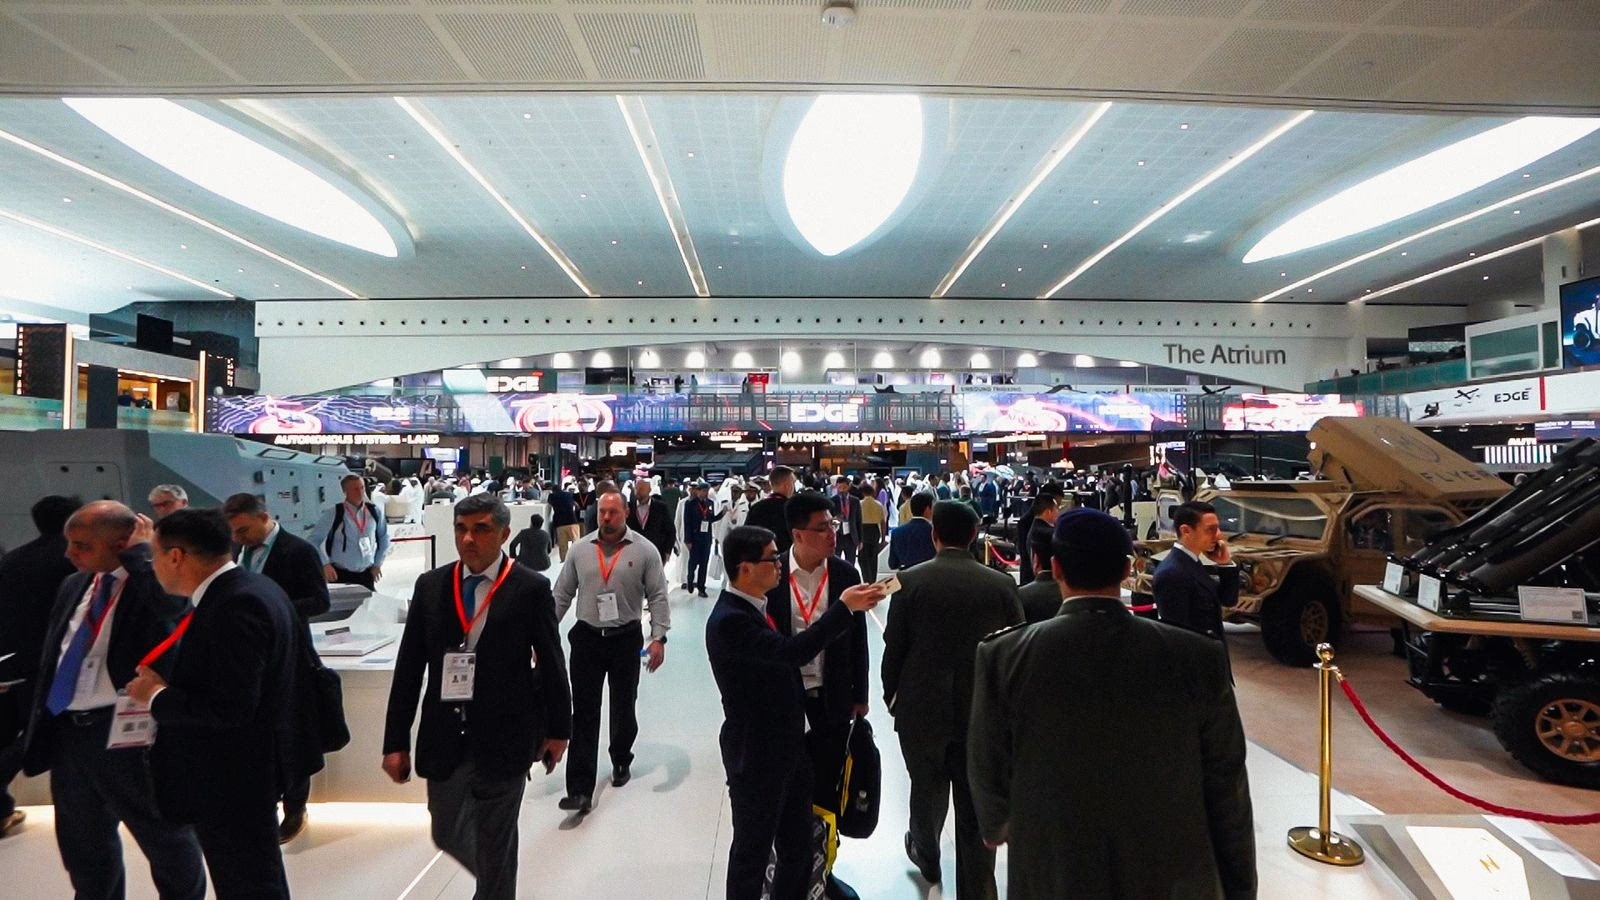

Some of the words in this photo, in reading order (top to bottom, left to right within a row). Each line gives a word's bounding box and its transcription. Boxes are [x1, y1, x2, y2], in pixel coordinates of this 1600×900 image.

[1163, 343, 1205, 364] The
[1209, 343, 1287, 364] Atrium
[487, 376, 540, 392] EDGE
[1494, 391, 1530, 403] EDGE
[790, 403, 859, 422] EDGE
[274, 434, 354, 445] AUTONOMOUS
[354, 434, 401, 445] SYSTEMS
[407, 434, 440, 445] LAND
[780, 432, 860, 444] AUTONOMOUS
[1418, 470, 1498, 482] FLYER
